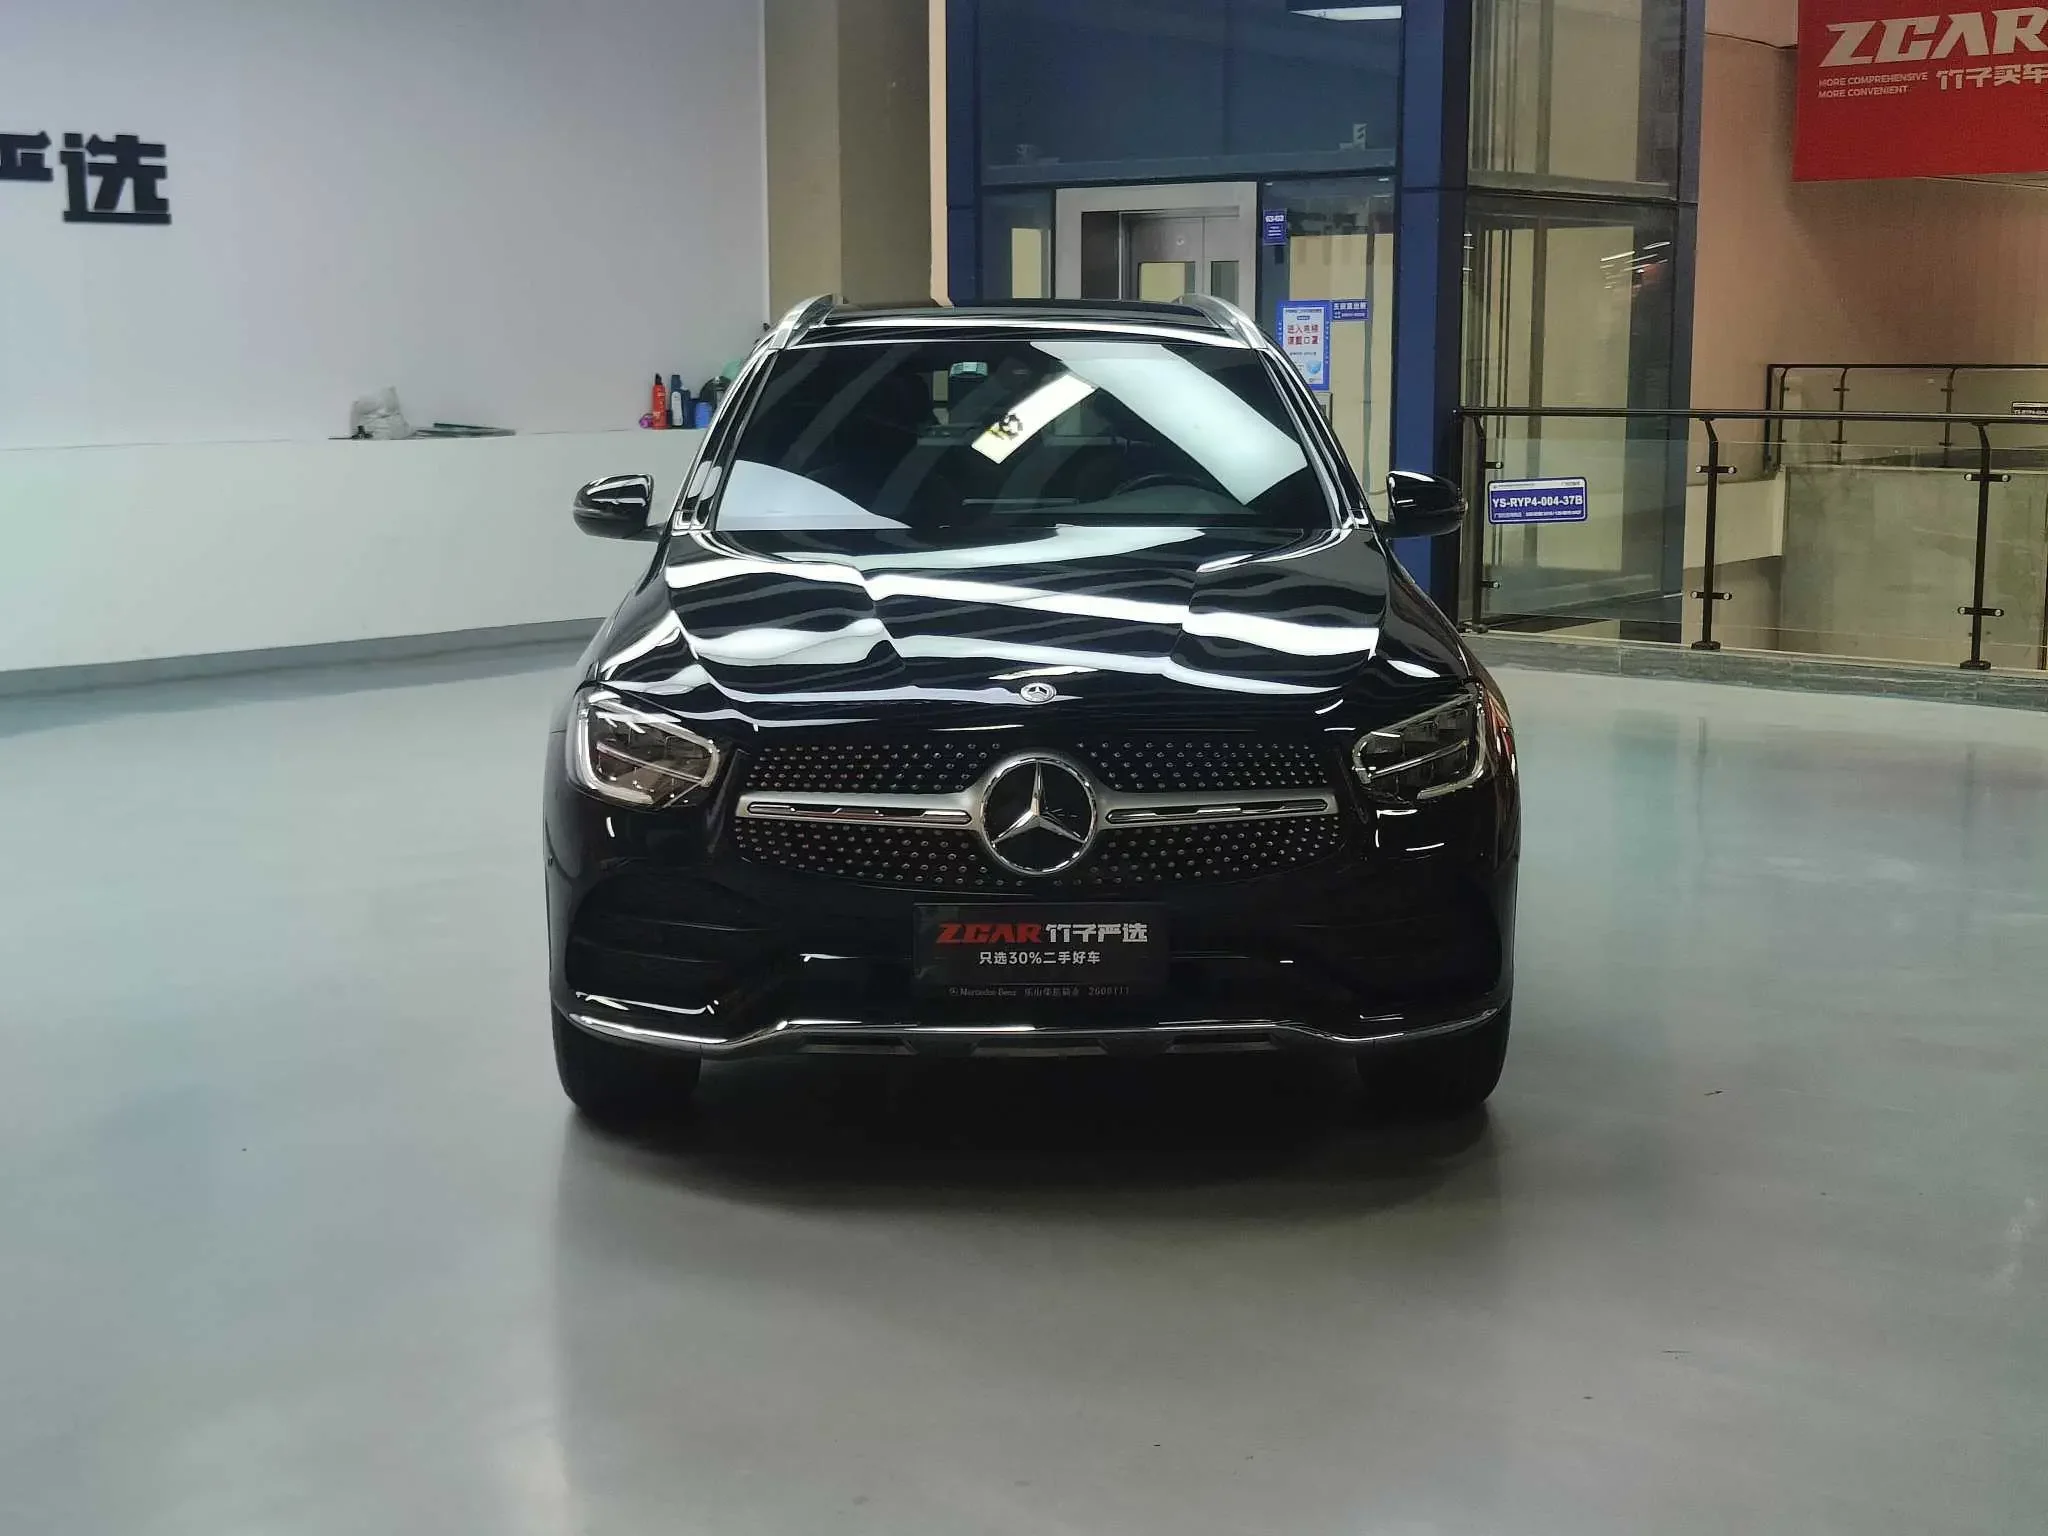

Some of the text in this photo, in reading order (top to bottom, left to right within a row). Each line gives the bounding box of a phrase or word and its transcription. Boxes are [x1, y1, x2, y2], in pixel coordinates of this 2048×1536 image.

[1819, 7, 2048, 67] ZCAR
[1818, 71, 1929, 88] MORE COMPREHENSIVE
[1936, 63, 2048, 90] 竹子买车
[1818, 85, 1908, 98] MORE CONVENIENT
[1492, 495, 1583, 508] YS-RYP4-004-37B
[936, 923, 1148, 943] ZCAR 竹子严选
[979, 951, 1101, 964] 只选30%二手好车
